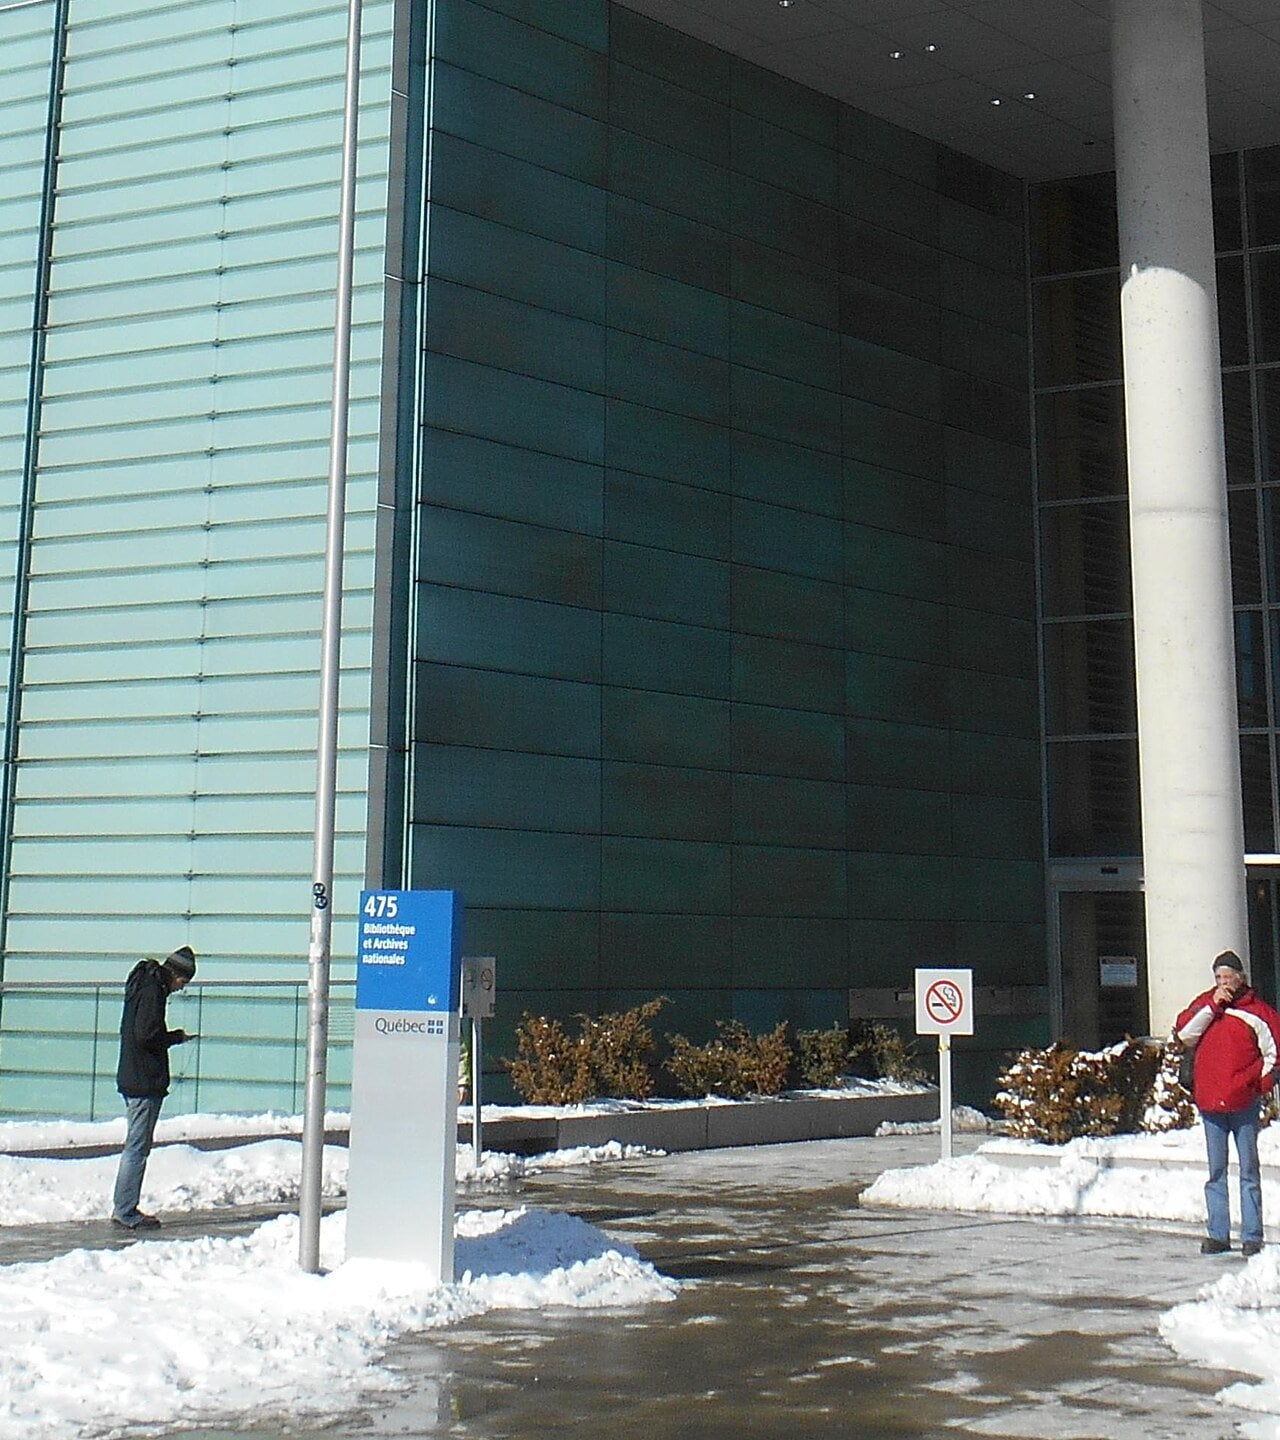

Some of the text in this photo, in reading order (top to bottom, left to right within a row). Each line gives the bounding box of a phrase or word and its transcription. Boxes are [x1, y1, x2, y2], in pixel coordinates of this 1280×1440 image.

[364, 895, 399, 918] 475
[363, 922, 416, 937] Bibliothèque
[362, 937, 408, 950] et Archives
[362, 953, 405, 965] nationales
[375, 1017, 426, 1035] Québec
